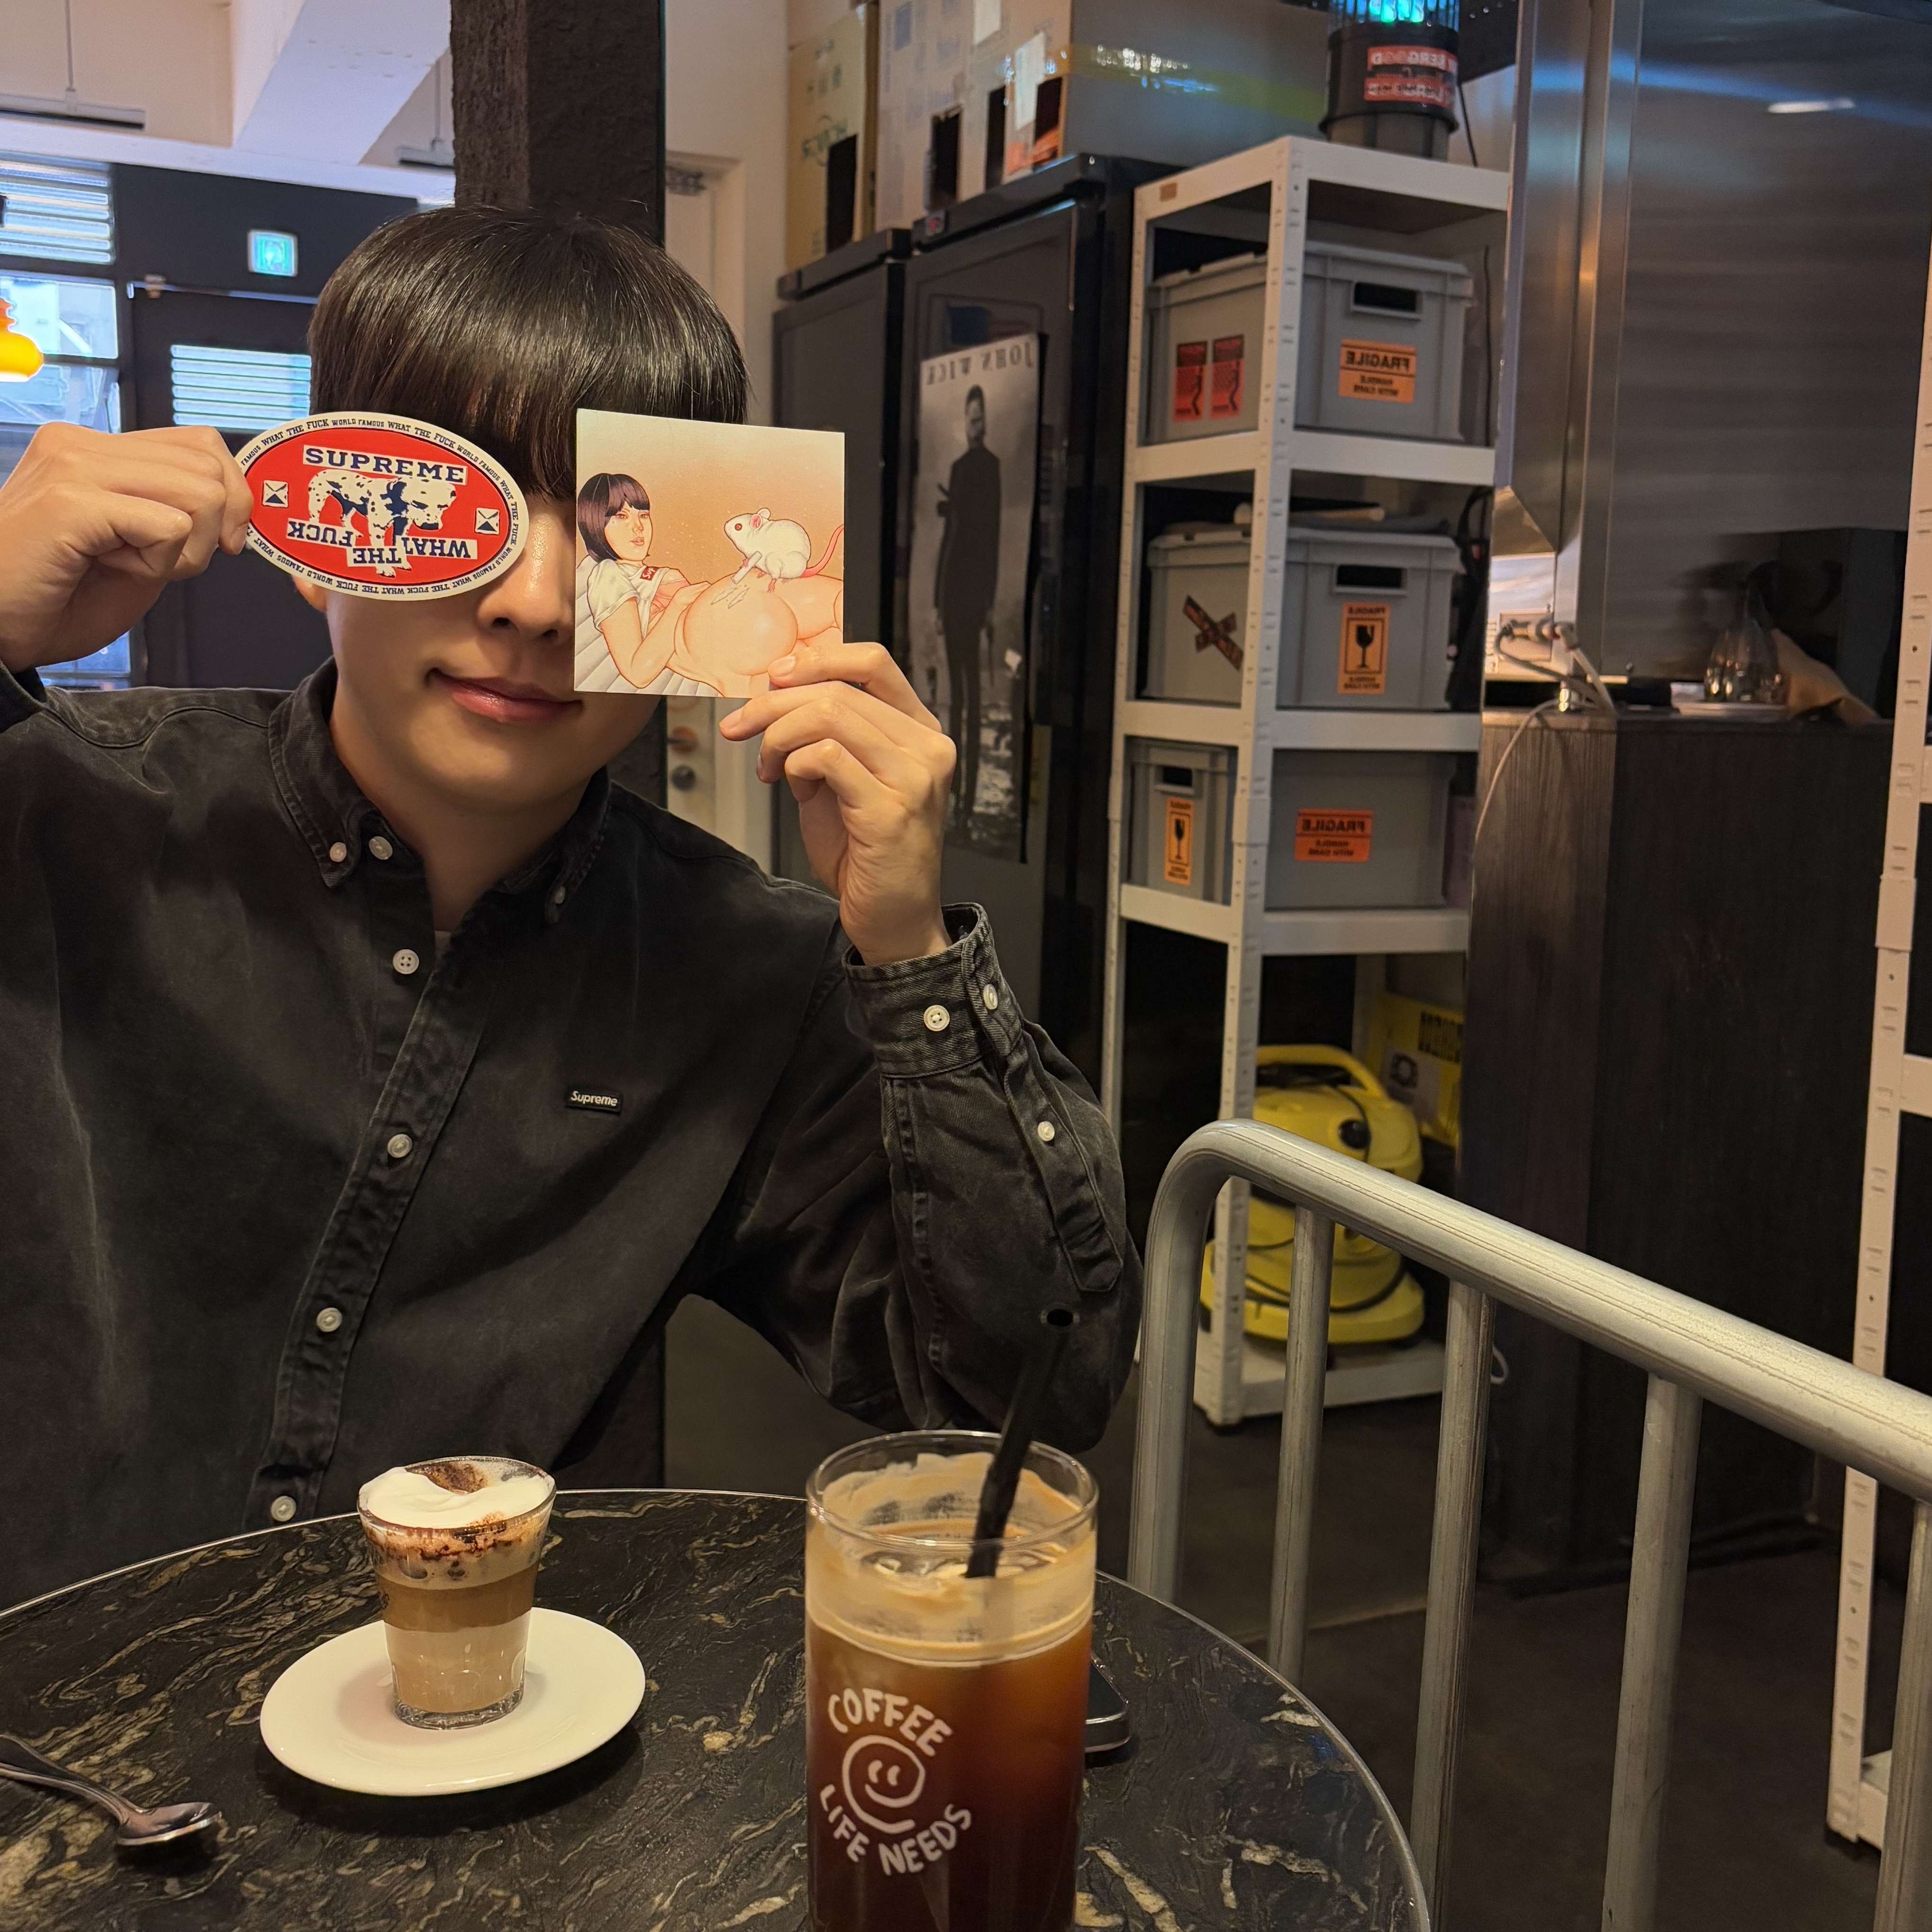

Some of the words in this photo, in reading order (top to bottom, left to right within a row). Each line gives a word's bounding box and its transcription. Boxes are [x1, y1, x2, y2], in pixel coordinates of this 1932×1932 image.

[286, 425, 304, 435] THE
[306, 419, 329, 429] FUCK
[388, 421, 411, 432] WHAT
[415, 427, 431, 438] THE
[261, 431, 284, 446] WHAT
[434, 433, 456, 449] FUCK
[241, 445, 261, 466] FAMOUS
[457, 444, 479, 462] WORLD
[306, 448, 464, 483] SUPREME
[479, 460, 500, 481] FAMOUS
[500, 480, 514, 500] WHAT
[287, 521, 354, 547] FUCK
[510, 523, 518, 545] FUCK
[254, 537, 274, 557] WHAT
[401, 537, 471, 558] WHAT
[276, 555, 305, 573] FAMOUS
[353, 548, 401, 564] THE
[496, 547, 513, 565] WORLD
[307, 570, 333, 585] WORLD
[472, 563, 496, 580] FAMOUS
[336, 580, 358, 591] FUCK
[362, 585, 379, 593] THE
[432, 583, 450, 591] THE
[452, 576, 472, 588] WHAT
[571, 1090, 617, 1107] Supreme
[828, 1687, 952, 1757] COFFEE
[820, 1784, 870, 1862] LIFE
[878, 1804, 971, 1876] NEEDS
